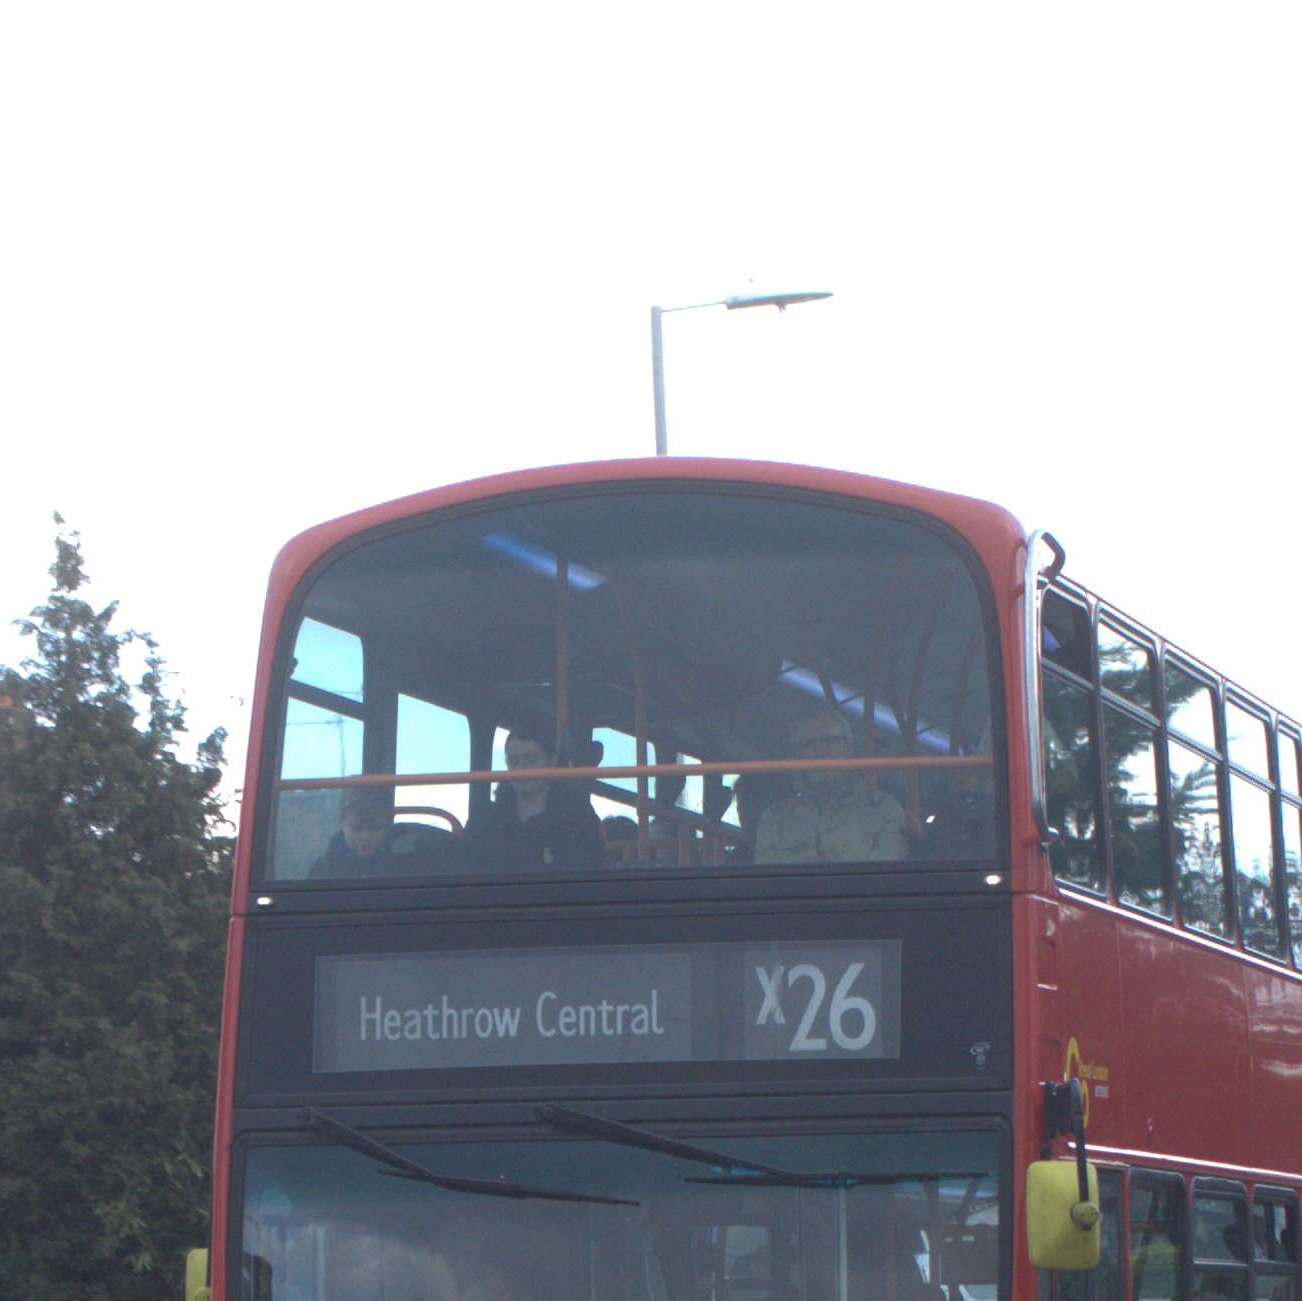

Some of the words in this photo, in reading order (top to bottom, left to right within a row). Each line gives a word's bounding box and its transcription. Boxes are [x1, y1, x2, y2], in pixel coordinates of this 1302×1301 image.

[359, 994, 522, 1042] Heathrow
[535, 989, 665, 1038] Central
[754, 962, 877, 1052] X26
